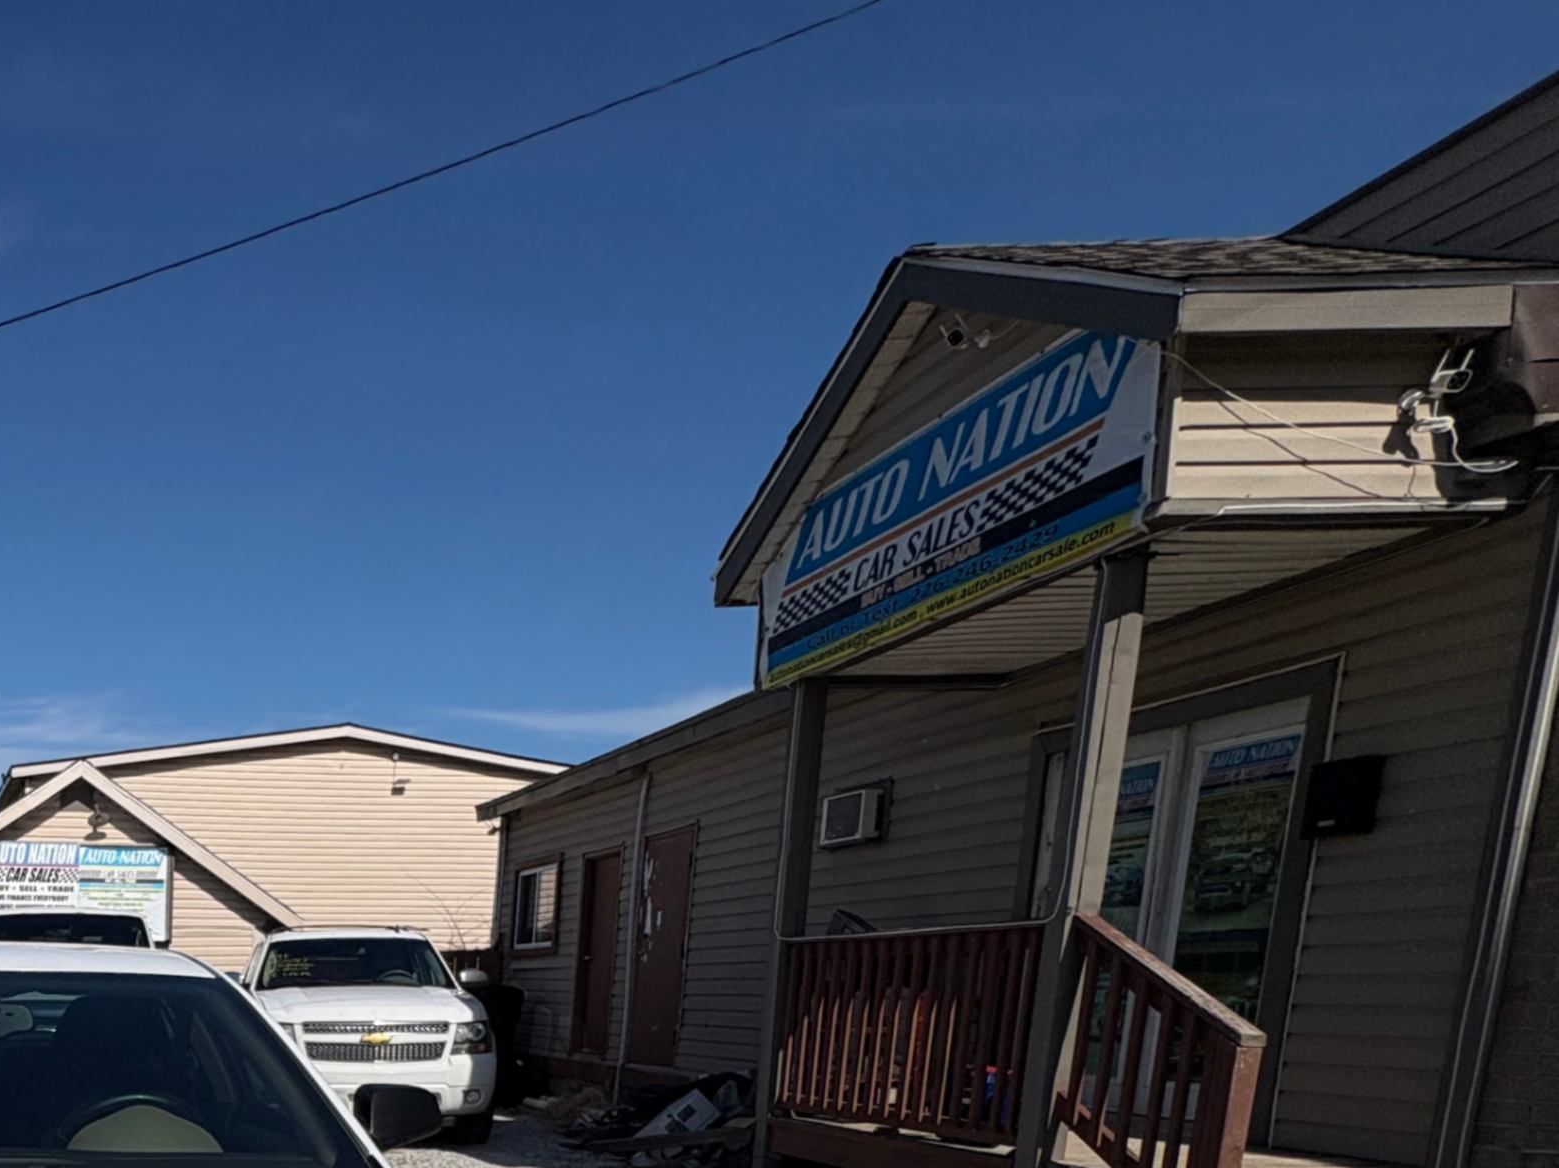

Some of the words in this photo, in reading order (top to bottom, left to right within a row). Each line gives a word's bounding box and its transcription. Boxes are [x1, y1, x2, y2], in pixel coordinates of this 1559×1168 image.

[796, 459, 909, 569] AUTO
[917, 336, 1127, 501] NATION
[853, 544, 898, 592] CAR
[903, 500, 981, 567] SALES
[933, 535, 981, 574] TRADE
[27, 842, 76, 865] NATION
[84, 848, 117, 864] AUTO
[117, 848, 163, 865] NATION
[5, 867, 29, 882] CAR
[29, 867, 61, 883] SALES
[47, 885, 75, 893] TRADE
